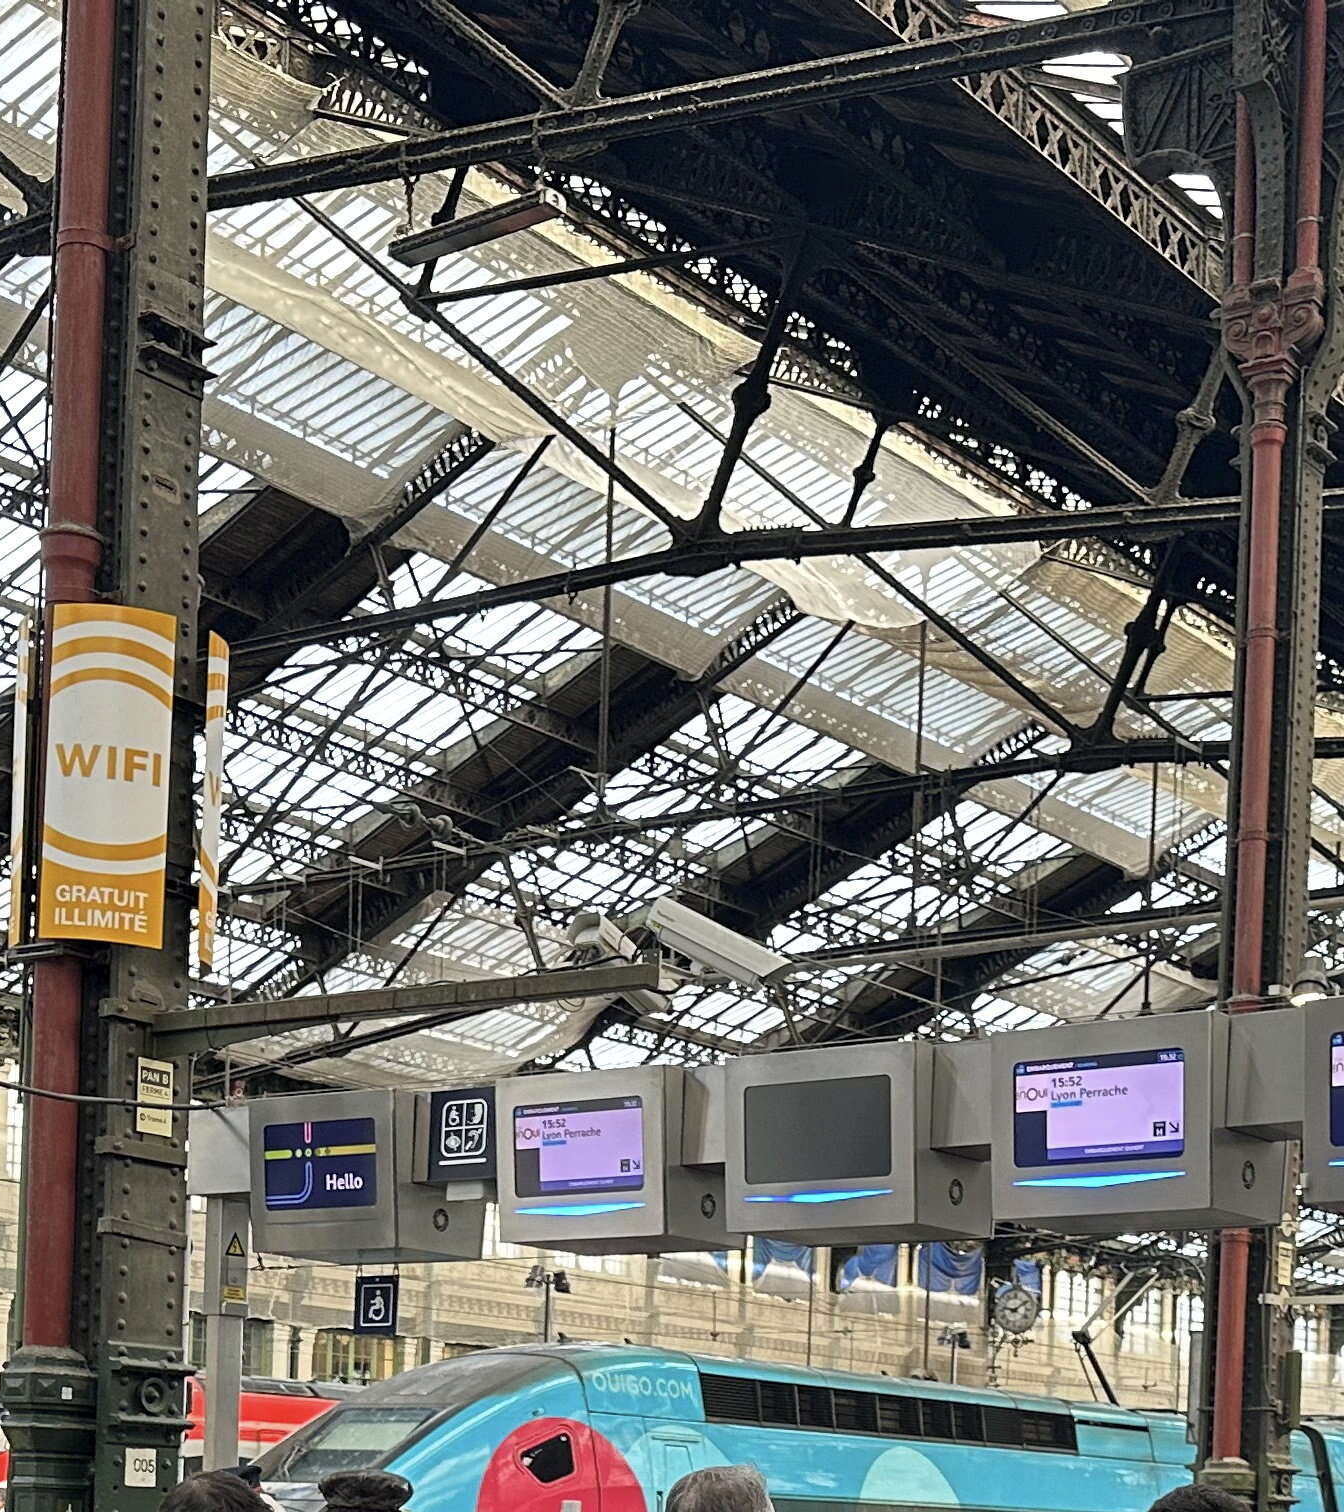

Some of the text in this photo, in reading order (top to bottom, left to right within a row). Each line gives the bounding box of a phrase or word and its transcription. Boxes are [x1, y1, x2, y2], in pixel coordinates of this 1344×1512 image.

[56, 743, 162, 787] WIFI
[55, 884, 149, 909] GRATUIT
[54, 907, 148, 933] ILLIMITÉ
[1050, 1076, 1082, 1088] 15:52
[1050, 1085, 1128, 1101] Lyon Perrache
[325, 1172, 363, 1192] Hello
[592, 1371, 694, 1399] OUIGO.COM
[133, 1458, 155, 1473] 005
